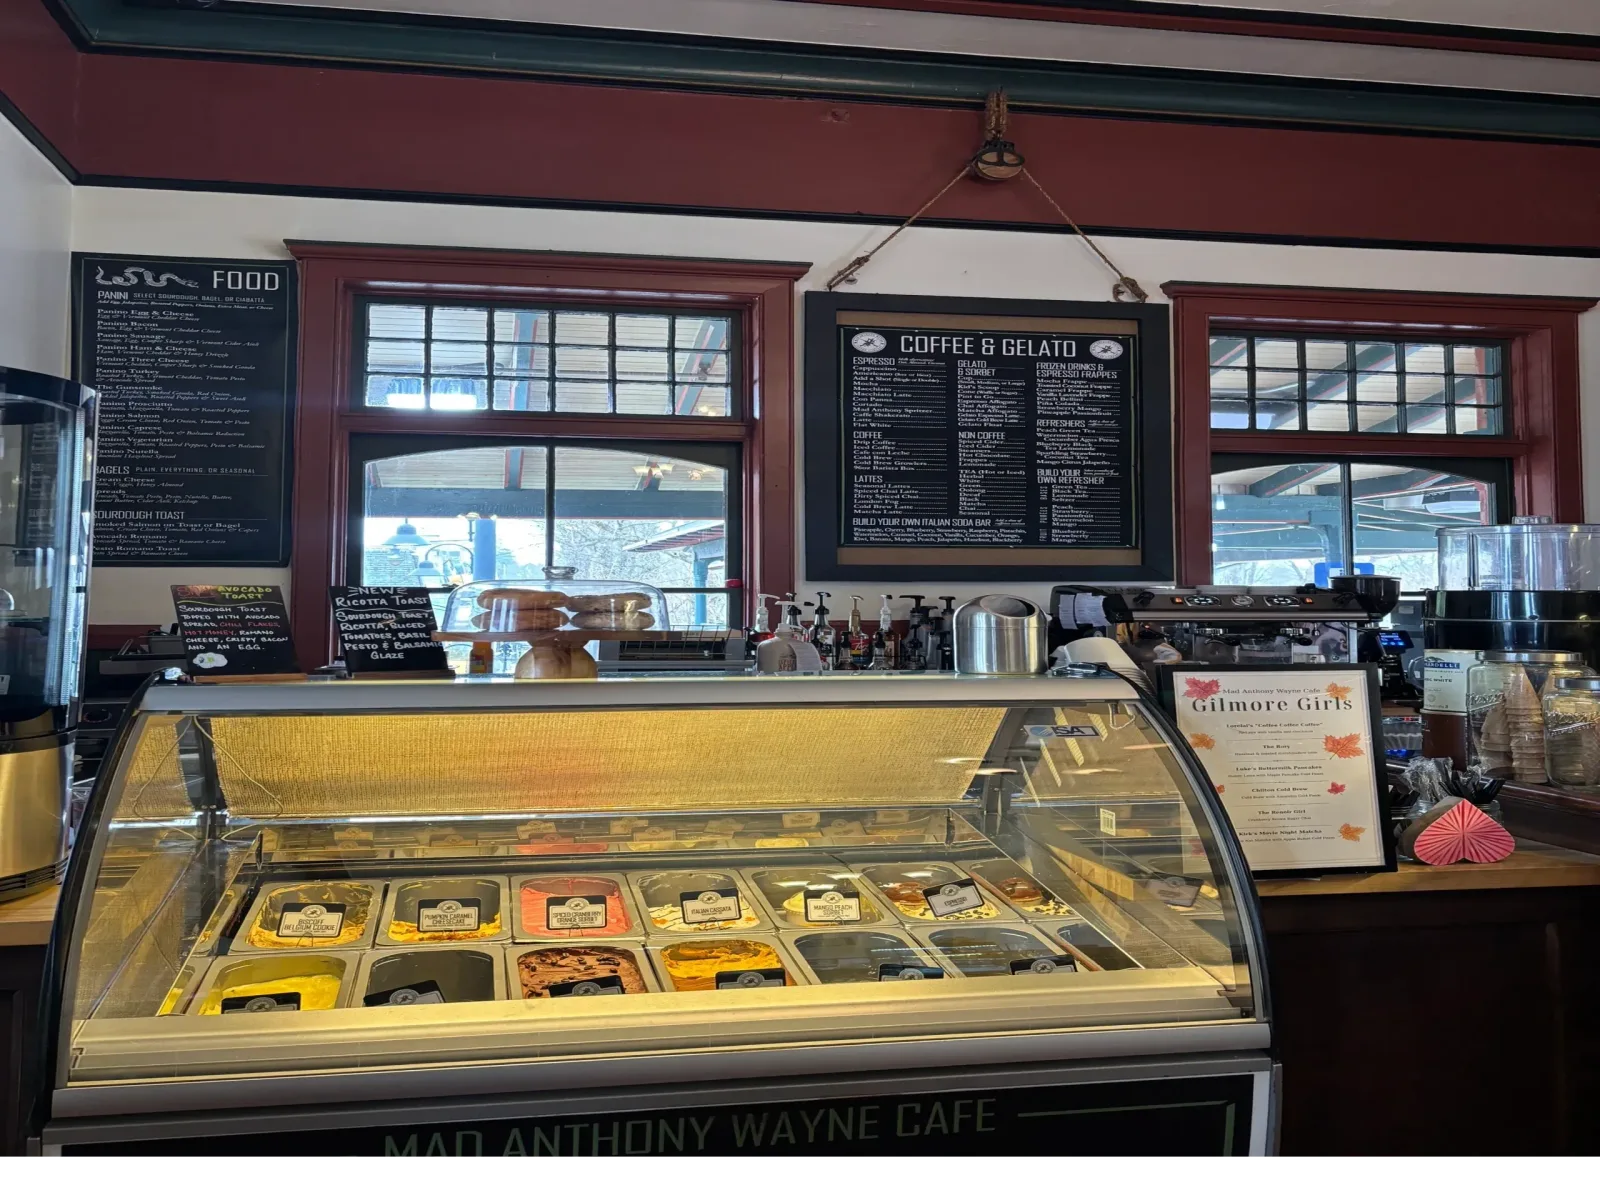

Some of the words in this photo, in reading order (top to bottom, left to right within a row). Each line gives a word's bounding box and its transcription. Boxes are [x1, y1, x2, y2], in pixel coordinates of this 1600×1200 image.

[213, 270, 279, 291] FOOD
[98, 291, 128, 299] PANINI
[901, 336, 974, 354] COFFEE
[982, 338, 996, 355] &
[1002, 340, 1076, 357] GELATO
[336, 597, 388, 606] RICOTTA
[391, 596, 428, 605] TOAST
[336, 612, 396, 621] SOURDOUGH
[383, 641, 389, 650] &
[1193, 698, 1287, 712] Gilmore
[1298, 697, 1352, 710] Girls
[385, 1131, 482, 1160] MAD
[502, 1117, 716, 1160] ANTHONY
[732, 1105, 880, 1147] WAYNE
[896, 1098, 996, 1137] CAFE
